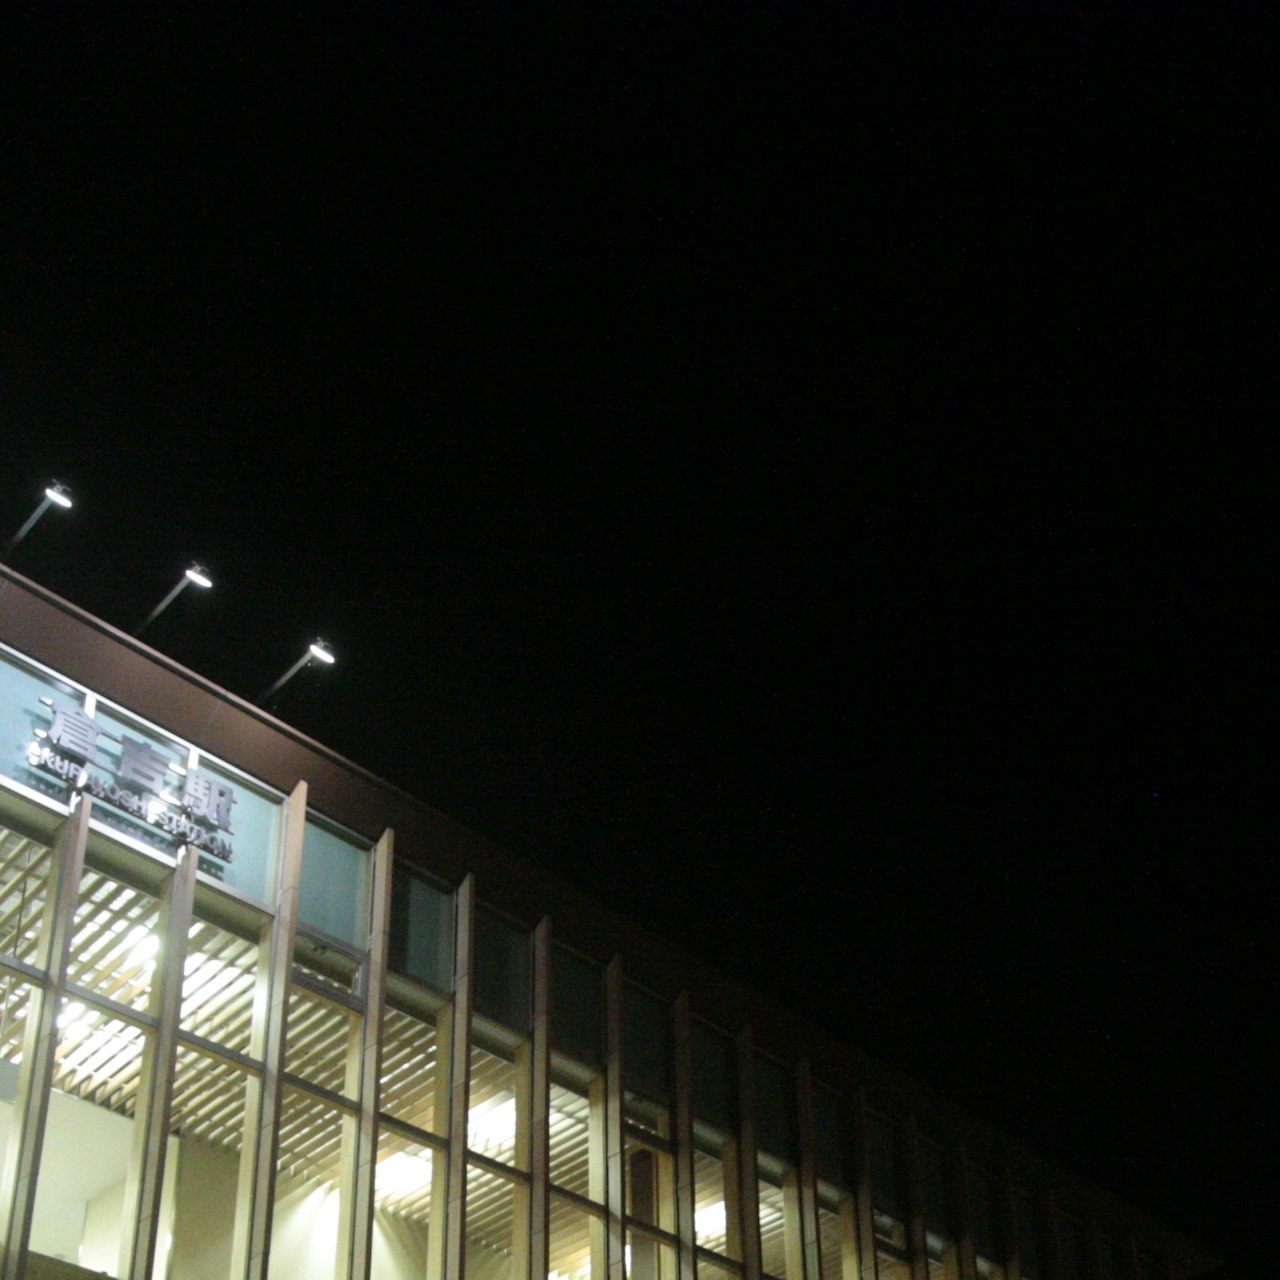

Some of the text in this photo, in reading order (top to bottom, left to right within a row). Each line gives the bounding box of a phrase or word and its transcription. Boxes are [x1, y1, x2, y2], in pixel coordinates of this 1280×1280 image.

[47, 700, 236, 838] 倉吉駅
[157, 811, 233, 862] STATION
